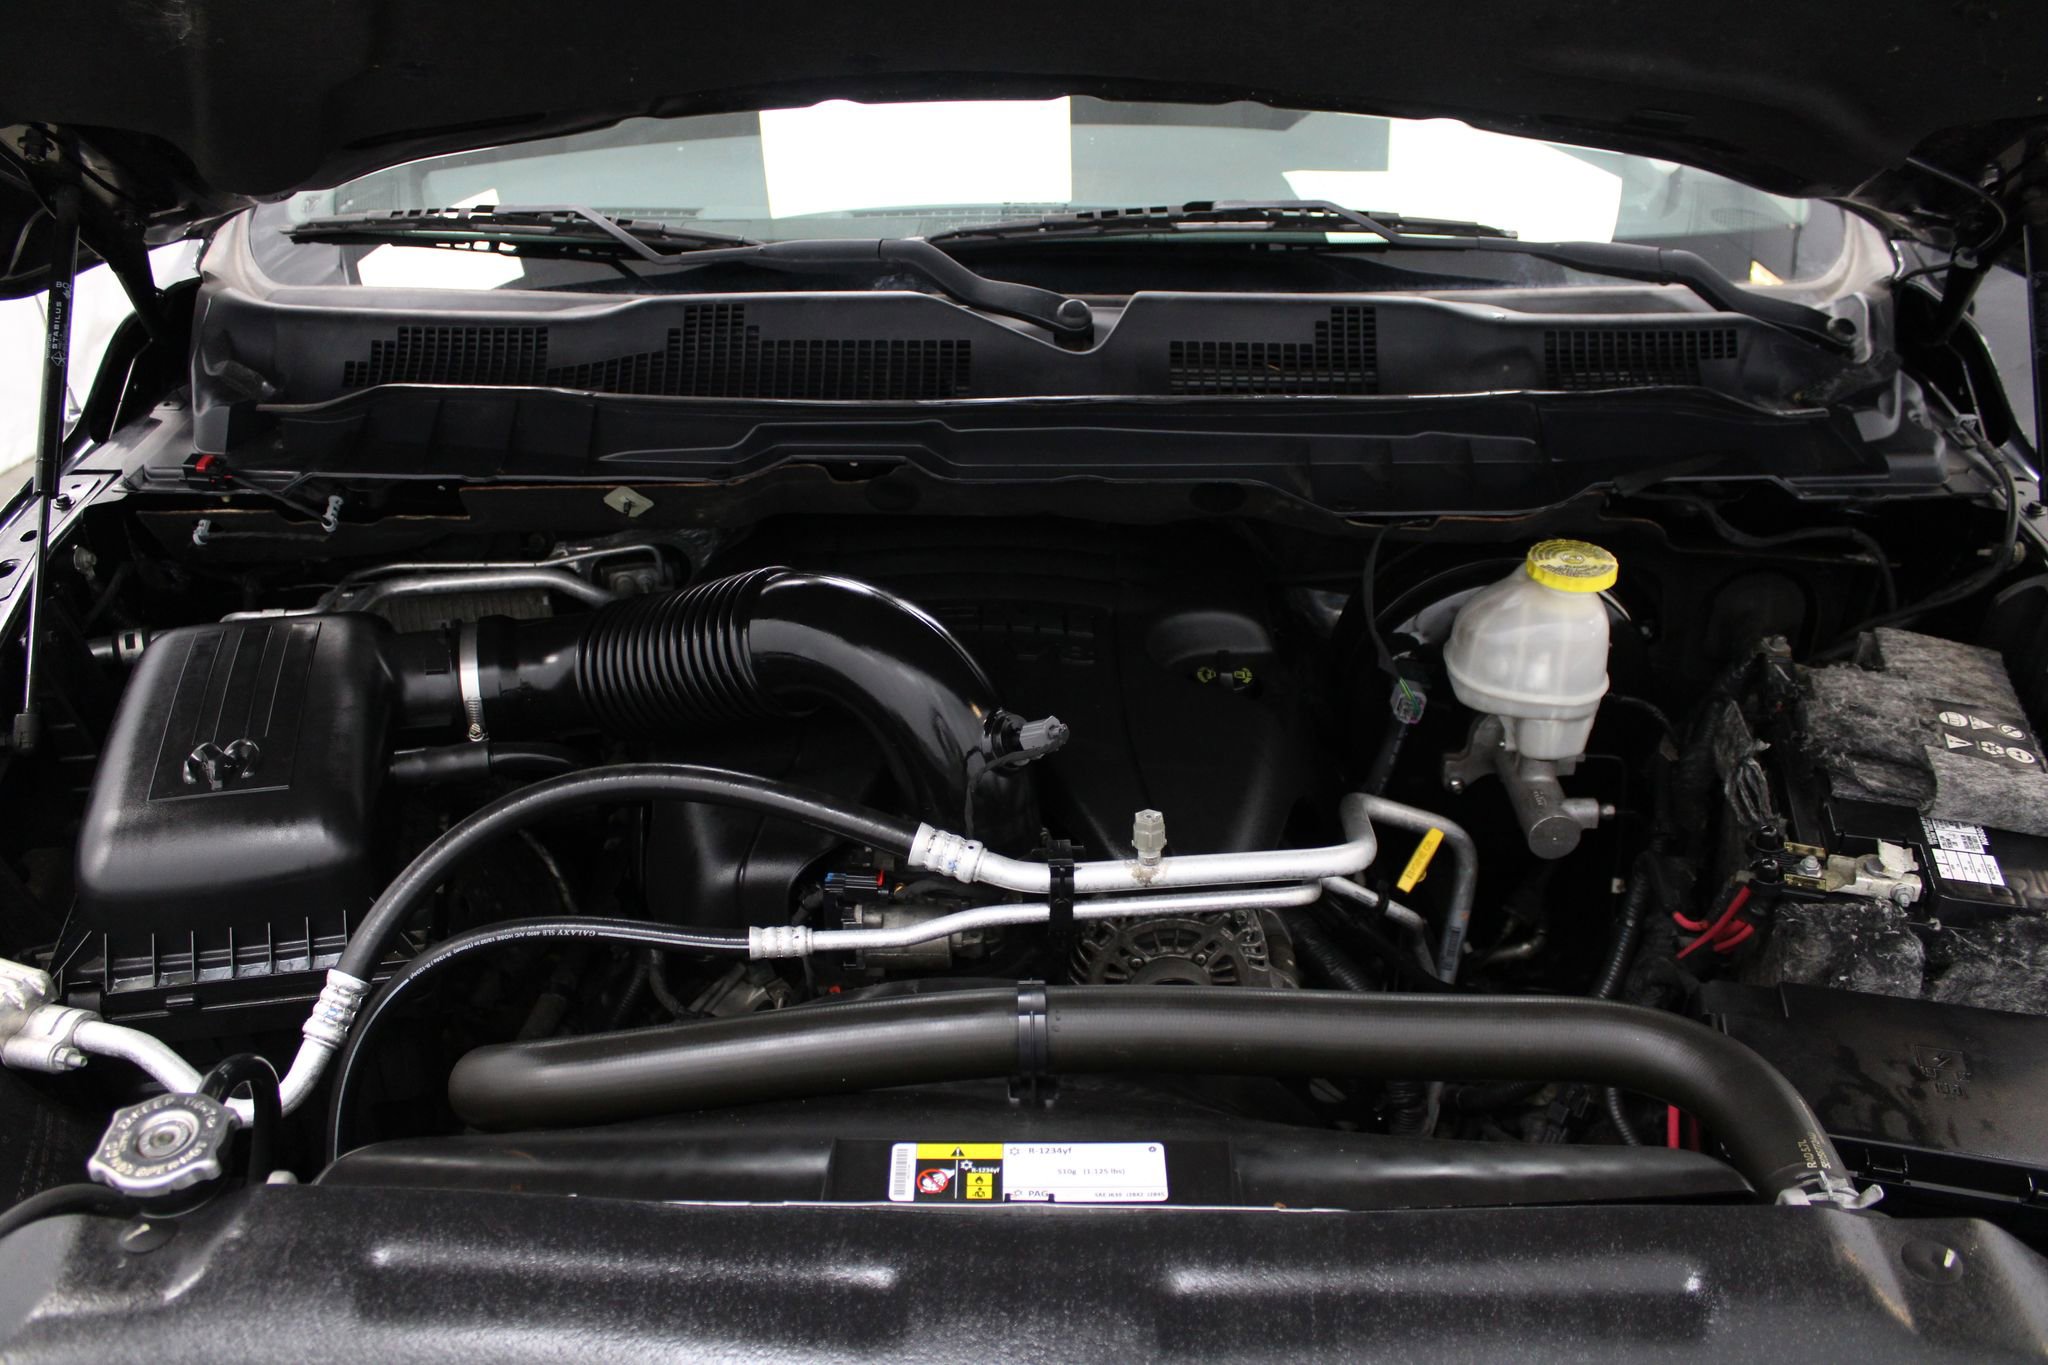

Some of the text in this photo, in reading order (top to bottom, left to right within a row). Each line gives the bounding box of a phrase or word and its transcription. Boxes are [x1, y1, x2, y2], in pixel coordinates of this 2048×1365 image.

[51, 301, 62, 350] STABILUS
[557, 929, 596, 937] GALAXY
[496, 933, 514, 942] HOSE
[1028, 1147, 1072, 1155] R-1234yf
[1803, 1153, 1817, 1168] RAD
[1028, 1190, 1049, 1198] PAG
